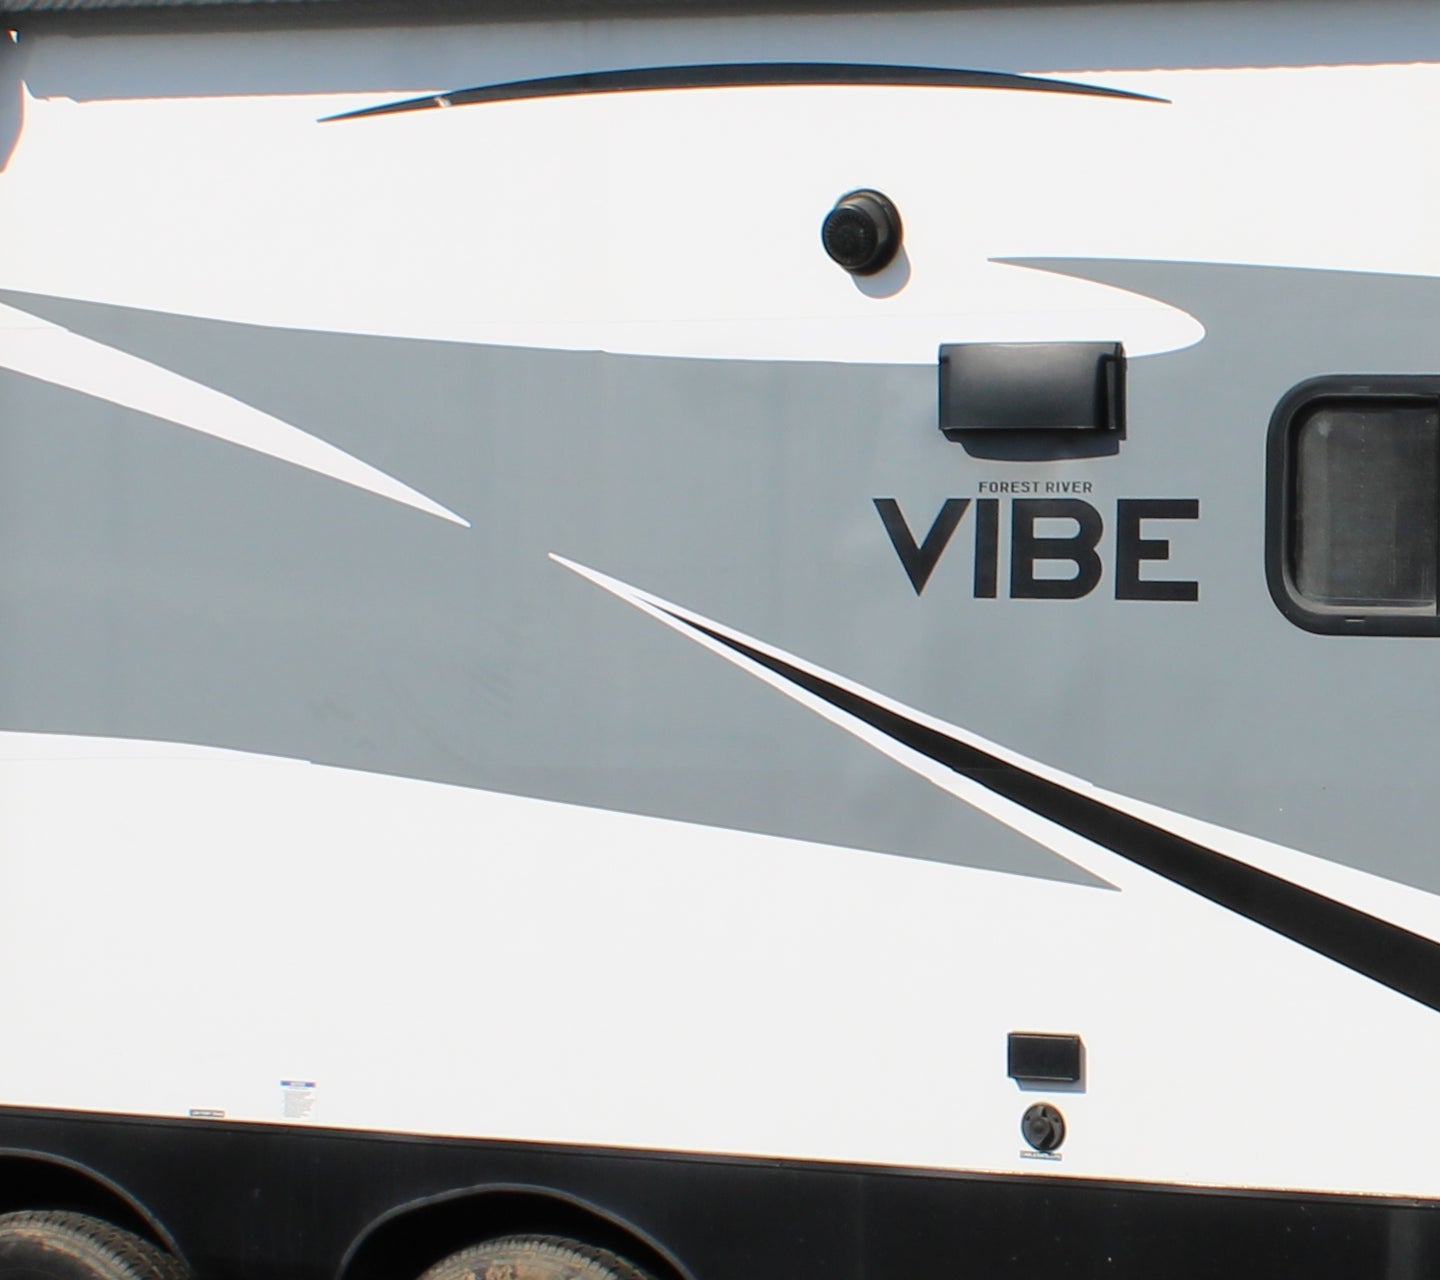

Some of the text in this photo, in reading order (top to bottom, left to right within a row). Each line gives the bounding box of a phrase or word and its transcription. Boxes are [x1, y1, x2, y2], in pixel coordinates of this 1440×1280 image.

[978, 481, 1093, 493] FOREST RIVER
[872, 498, 1199, 602] VIBE
